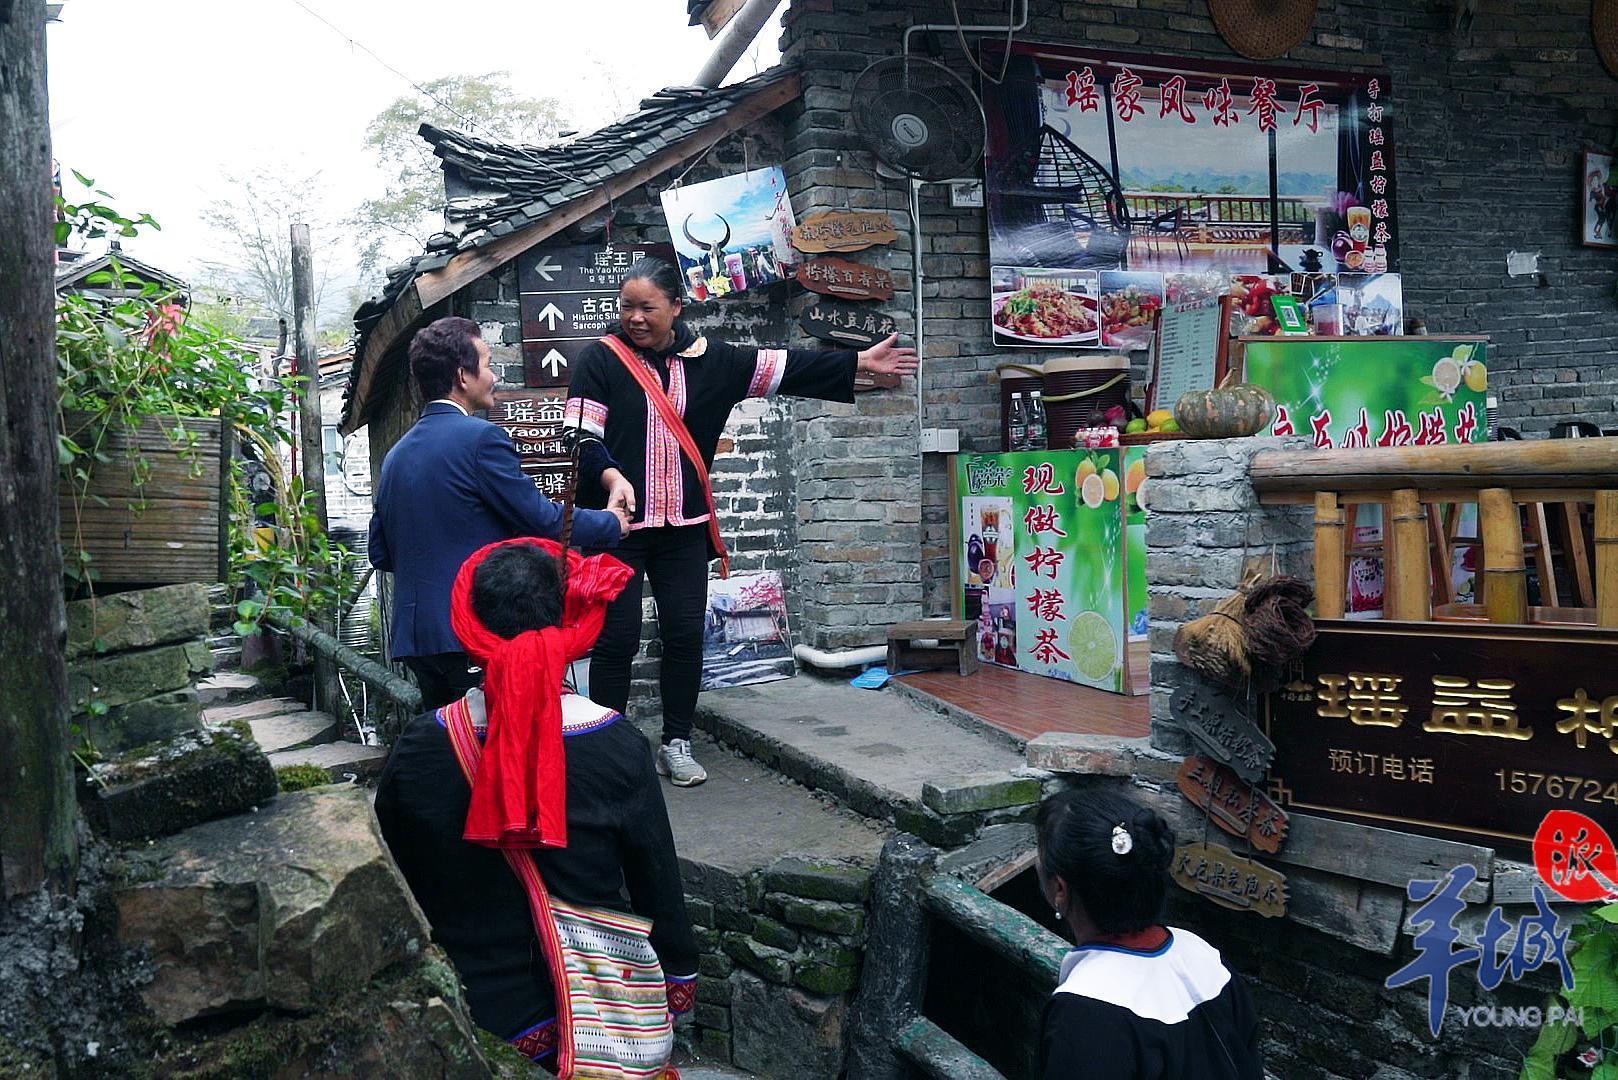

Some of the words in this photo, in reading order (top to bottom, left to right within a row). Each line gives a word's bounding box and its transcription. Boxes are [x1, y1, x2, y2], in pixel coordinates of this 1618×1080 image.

[1065, 66, 1326, 133] 瑶家风味餐厅
[579, 266, 594, 274] The
[596, 266, 611, 274] Yao
[805, 262, 890, 289] 柠檬百香果
[572, 313, 604, 321] Historic
[572, 322, 609, 330] Sarcoph
[809, 306, 897, 335] 山水豆腐花
[503, 398, 566, 423] 瑶益
[503, 425, 556, 438] Yaoyi
[1022, 462, 1071, 665] 现做柠檬茶
[1328, 747, 1435, 784] 预订电话
